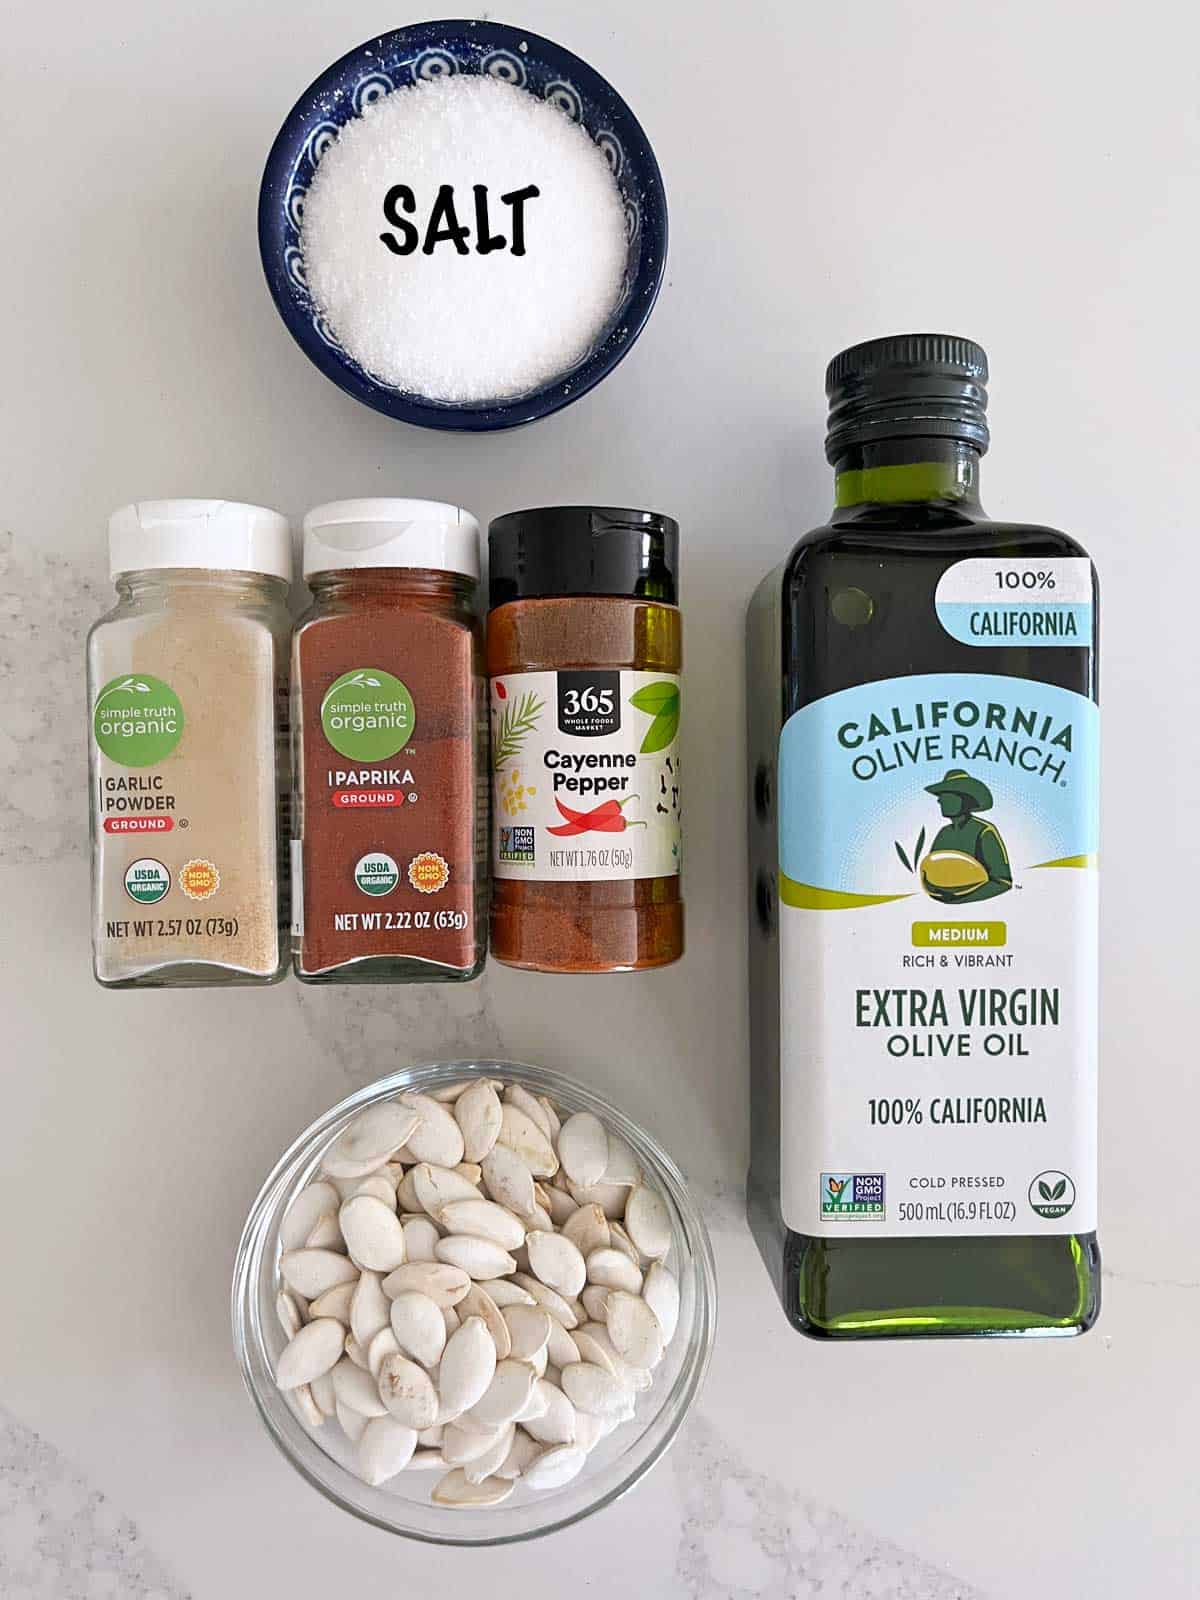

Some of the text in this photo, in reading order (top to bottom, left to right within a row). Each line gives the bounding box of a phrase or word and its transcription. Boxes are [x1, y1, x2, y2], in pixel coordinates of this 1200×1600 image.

[994, 571, 1056, 589] 100%
[969, 611, 1077, 636] CALIFORNIA
[330, 701, 406, 715] simple truth
[564, 686, 614, 715] 365
[100, 706, 176, 719] simple truth
[101, 718, 177, 737] organic
[330, 714, 407, 731] organic
[837, 701, 1073, 752] CALIFORNIA
[543, 750, 636, 772] Cayenne
[851, 735, 943, 781] OLIVE
[105, 776, 163, 791] GARLIC
[335, 769, 415, 785] PAPRIKA
[553, 773, 629, 795] Pepper
[105, 796, 176, 812] POWDER
[341, 793, 395, 804] GROUND
[111, 819, 166, 830] GROUND
[550, 848, 632, 869] NET WT 1.76 OZ (50g)
[134, 869, 161, 880] USDA
[363, 862, 390, 873] USDA
[360, 876, 393, 885] ORGANIC
[418, 872, 440, 880] GMO
[131, 883, 164, 892] ORGANIC
[107, 918, 239, 938] NET WT 2.57 OZ (73g)
[335, 911, 468, 931] NET WT 2.22 OZ (63g)
[929, 928, 989, 941] MEDIUM
[902, 955, 1014, 967] RICH & VIBRANT
[856, 988, 1059, 1027] EXTRA VIRGIN
[887, 1033, 1029, 1057] OLIVE OIL
[868, 1097, 1047, 1125] 100% CALIFORNIA
[856, 1177, 881, 1186] NON
[909, 1177, 1005, 1188] COLD PRESSED
[855, 1186, 882, 1194] GMO
[855, 1194, 881, 1203] Project
[826, 1204, 881, 1212] VERIFIED
[899, 1202, 923, 1220] 500
[1038, 1206, 1067, 1214] VEGAN
